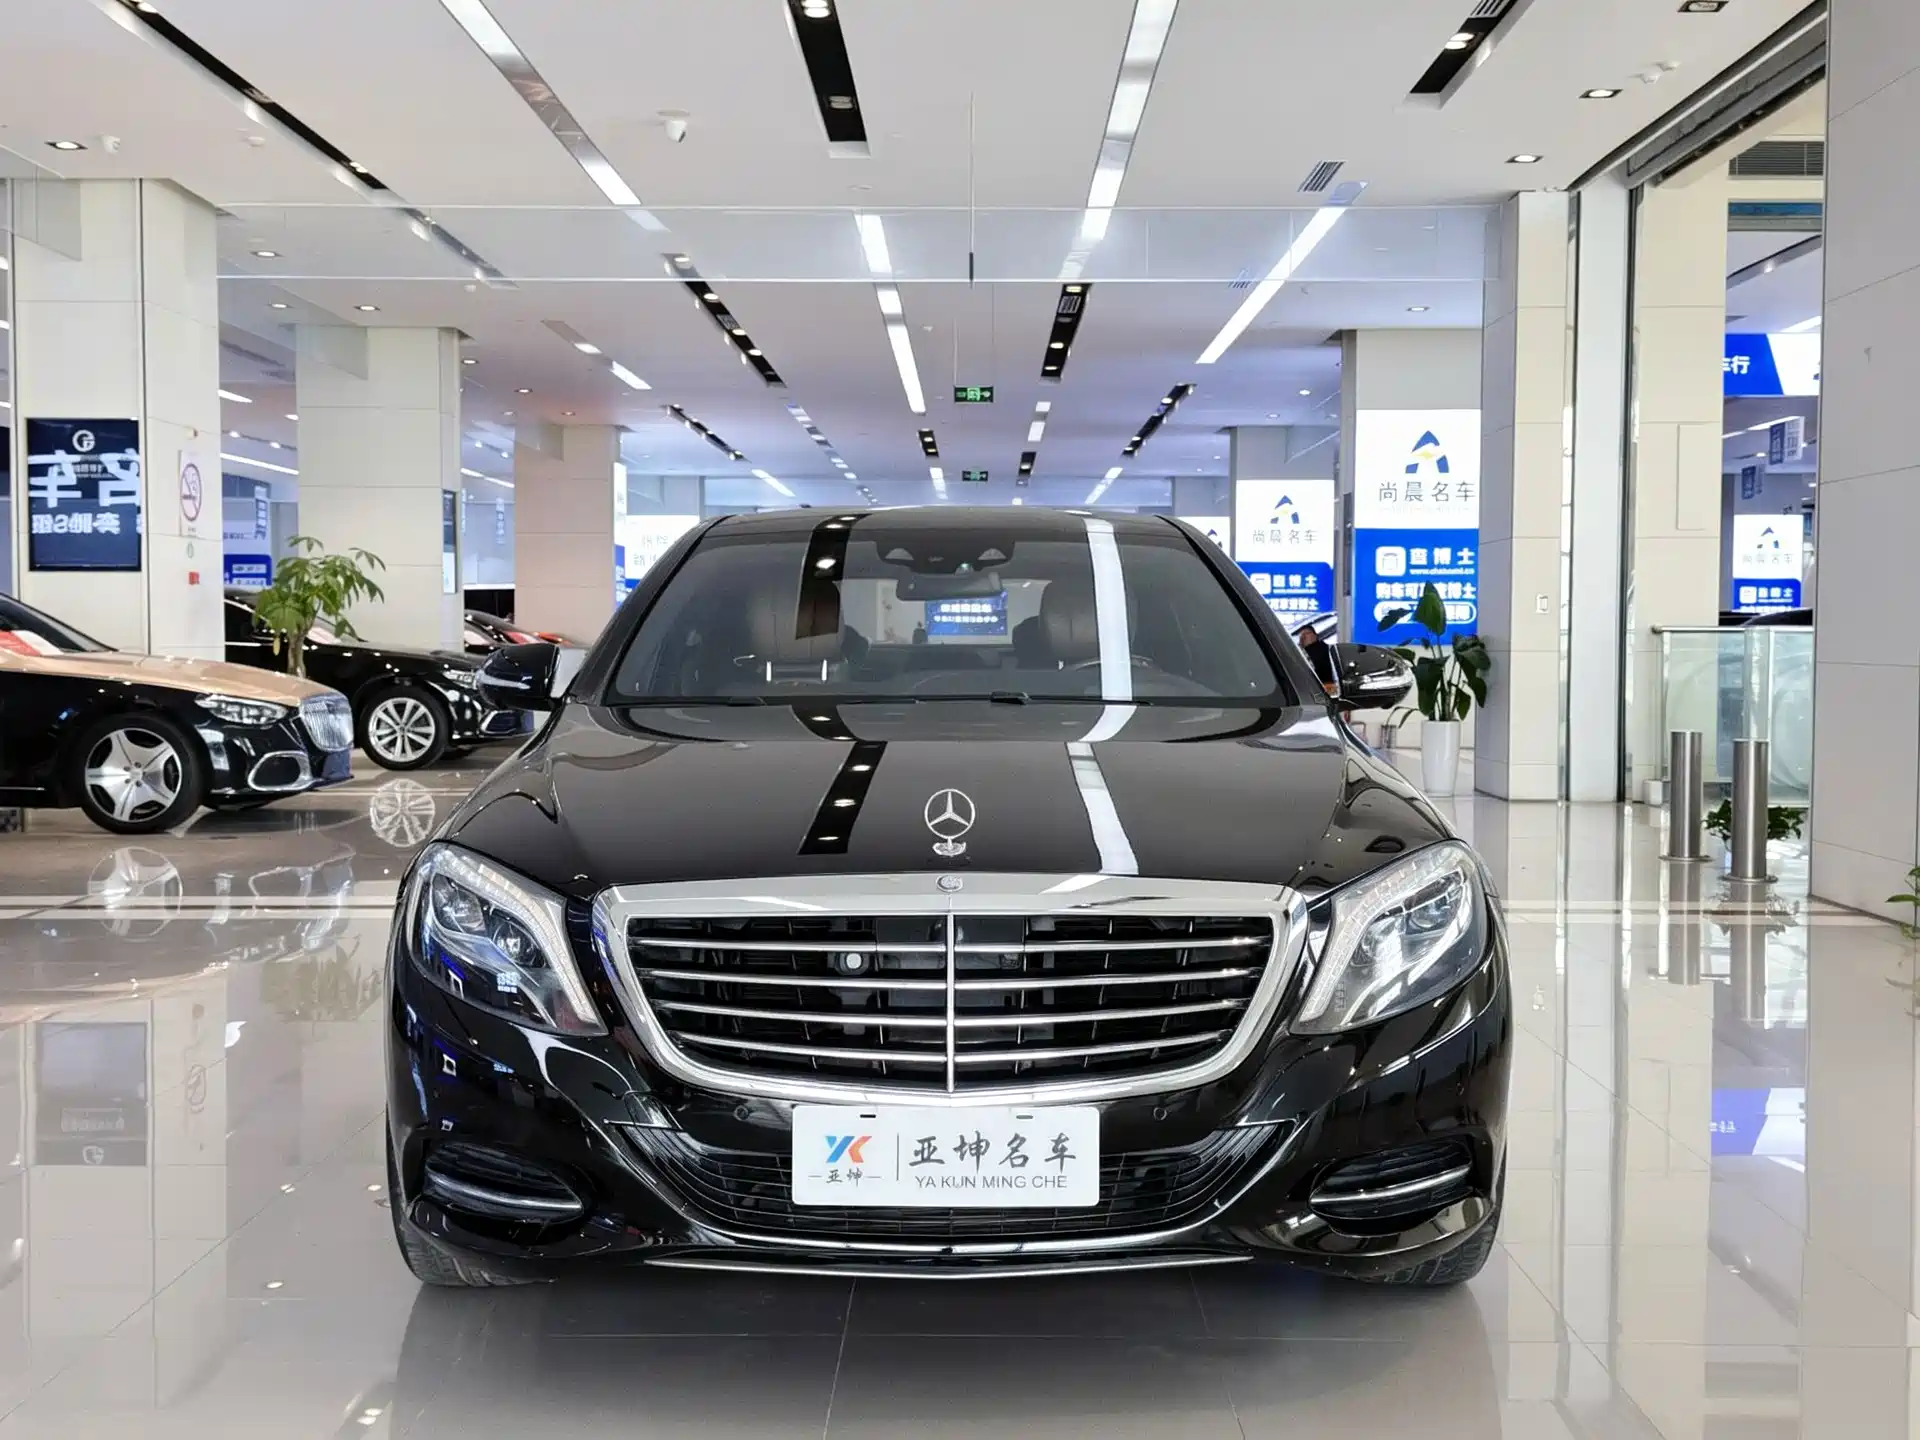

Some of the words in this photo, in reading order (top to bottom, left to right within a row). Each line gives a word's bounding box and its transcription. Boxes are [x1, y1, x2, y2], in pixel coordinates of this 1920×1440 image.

[1379, 480, 1477, 503] 尚晨名车
[909, 1130, 1077, 1173] 亚坤名车
[825, 1167, 864, 1187] 亚坤
[915, 1175, 937, 1189] YA
[941, 1175, 976, 1189] KUN
[982, 1175, 1027, 1189] MING
[1031, 1175, 1067, 1189] CHE
